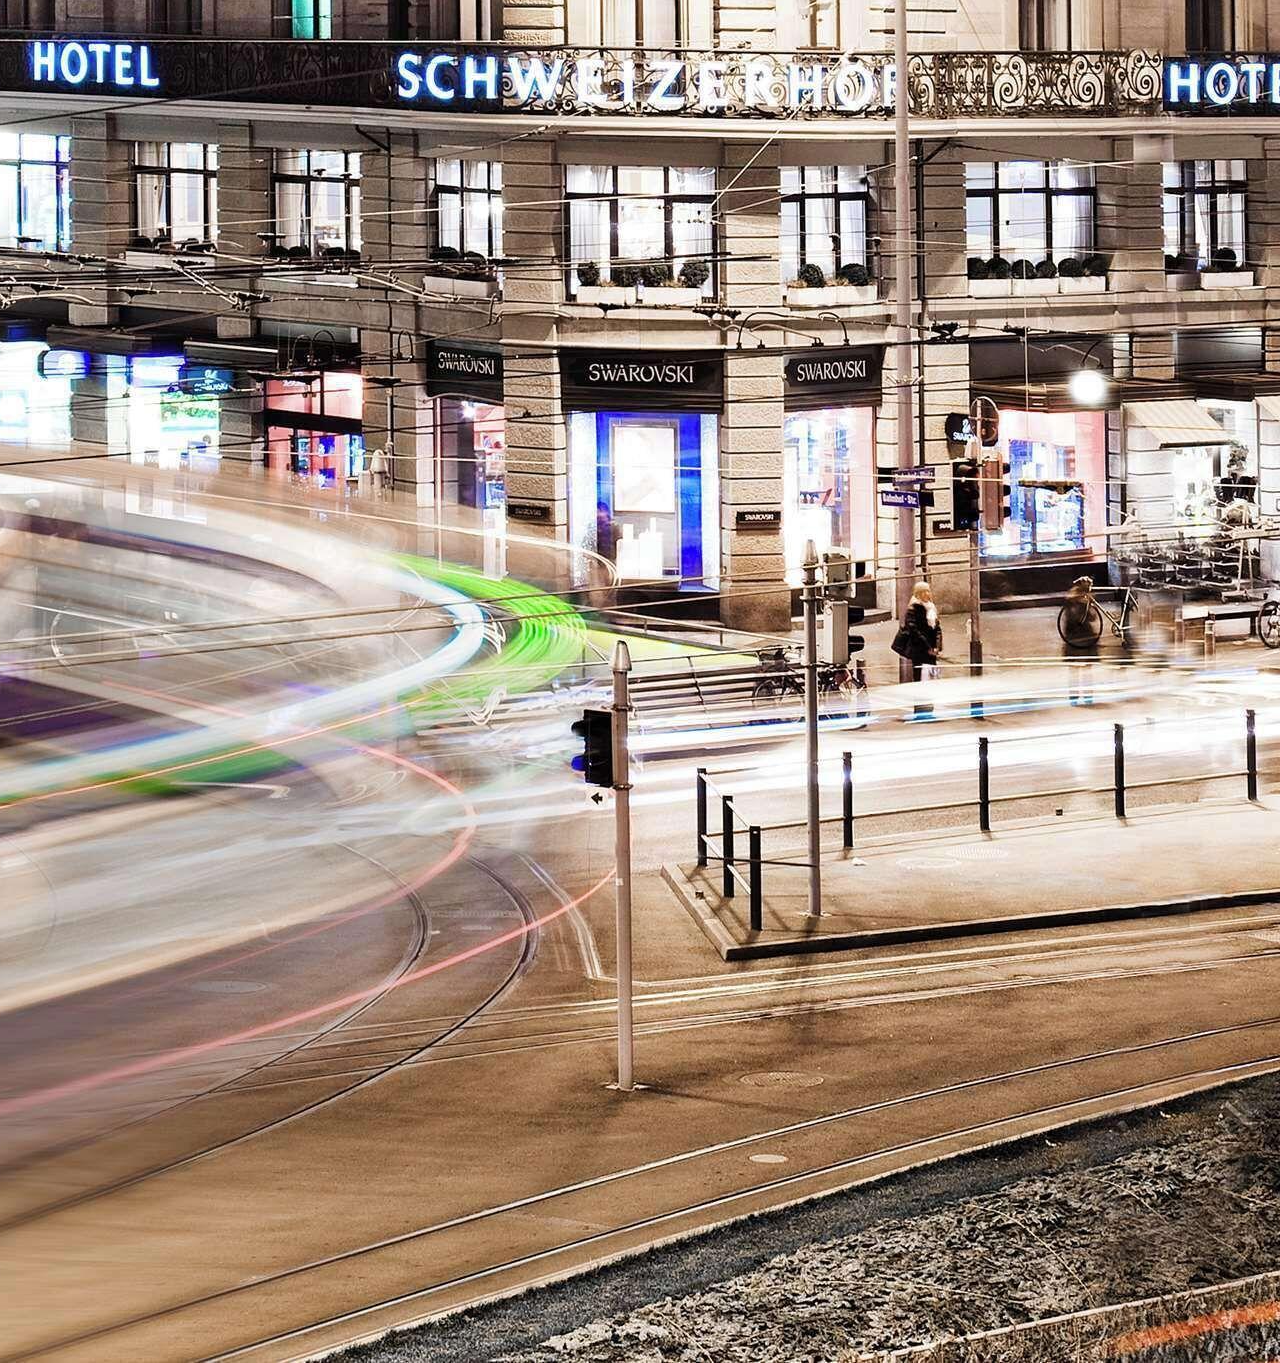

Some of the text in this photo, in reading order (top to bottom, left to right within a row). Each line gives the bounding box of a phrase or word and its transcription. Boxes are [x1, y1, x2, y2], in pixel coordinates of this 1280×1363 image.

[32, 41, 160, 87] HOTEL
[397, 52, 896, 113] SCHWEIZERHOF
[437, 351, 495, 376] SWAROVSKI
[588, 363, 694, 383] SWAROVSKI
[796, 360, 867, 382] SWAROVSKI
